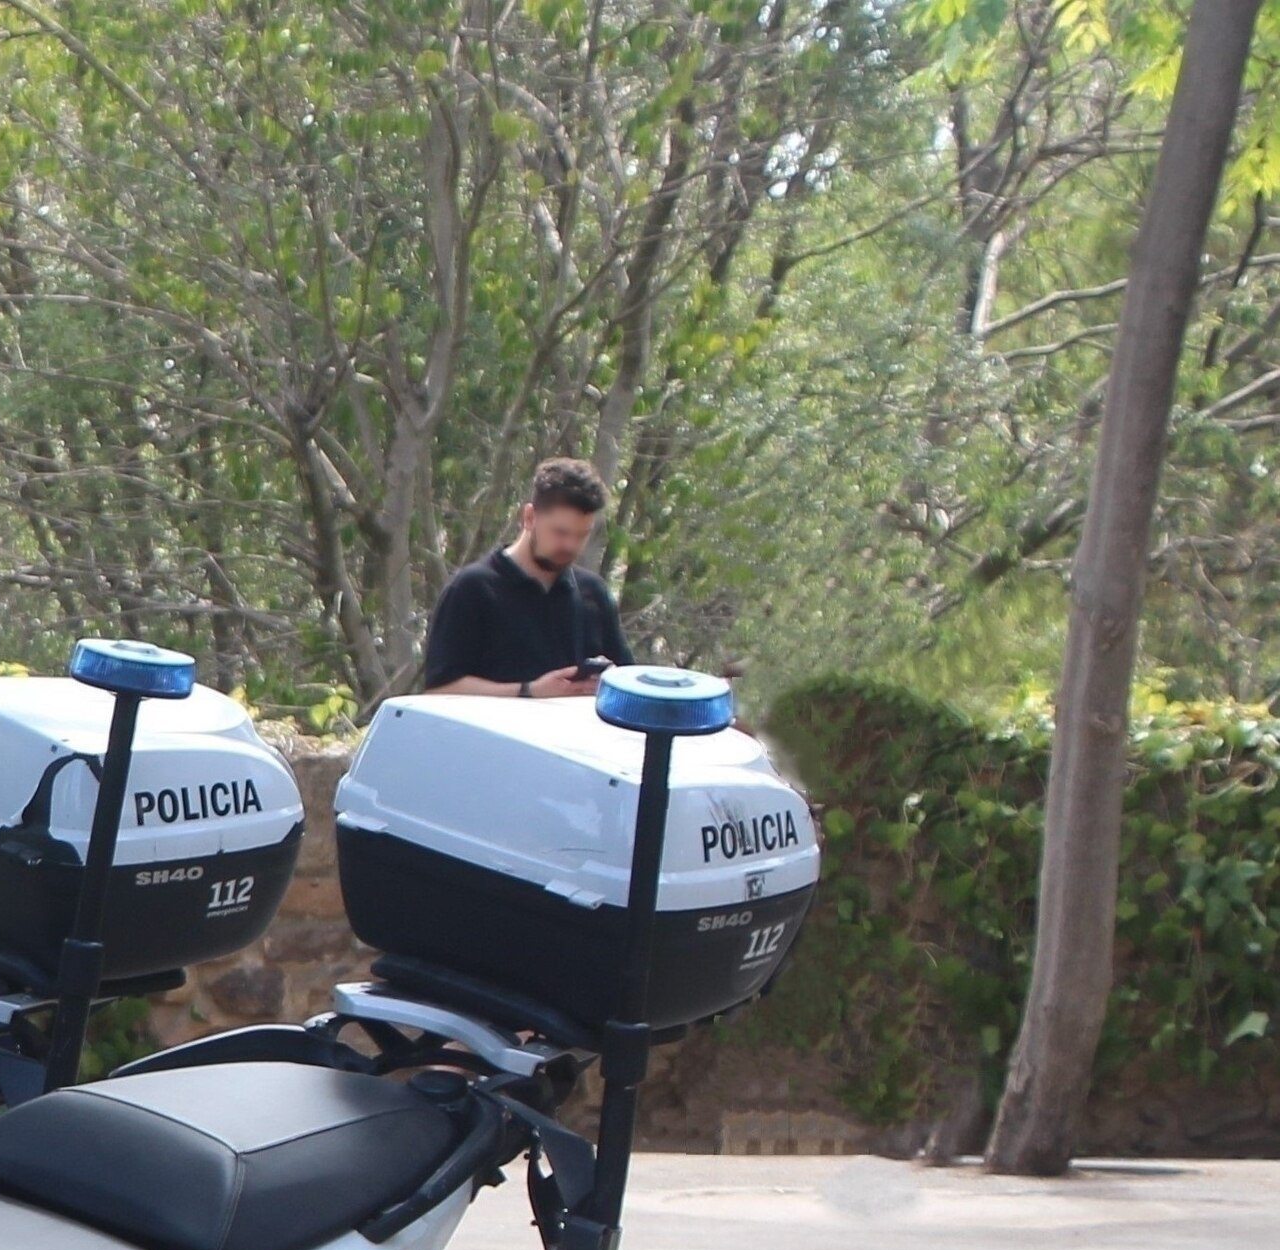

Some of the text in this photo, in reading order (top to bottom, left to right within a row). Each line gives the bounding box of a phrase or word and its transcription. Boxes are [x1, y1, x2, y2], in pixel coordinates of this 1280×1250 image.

[134, 779, 263, 827] POLICIA
[701, 810, 799, 863] POLICIA
[135, 866, 204, 886] SH40
[207, 876, 255, 909] 112
[697, 911, 753, 932] SH40
[743, 923, 786, 960] 112
